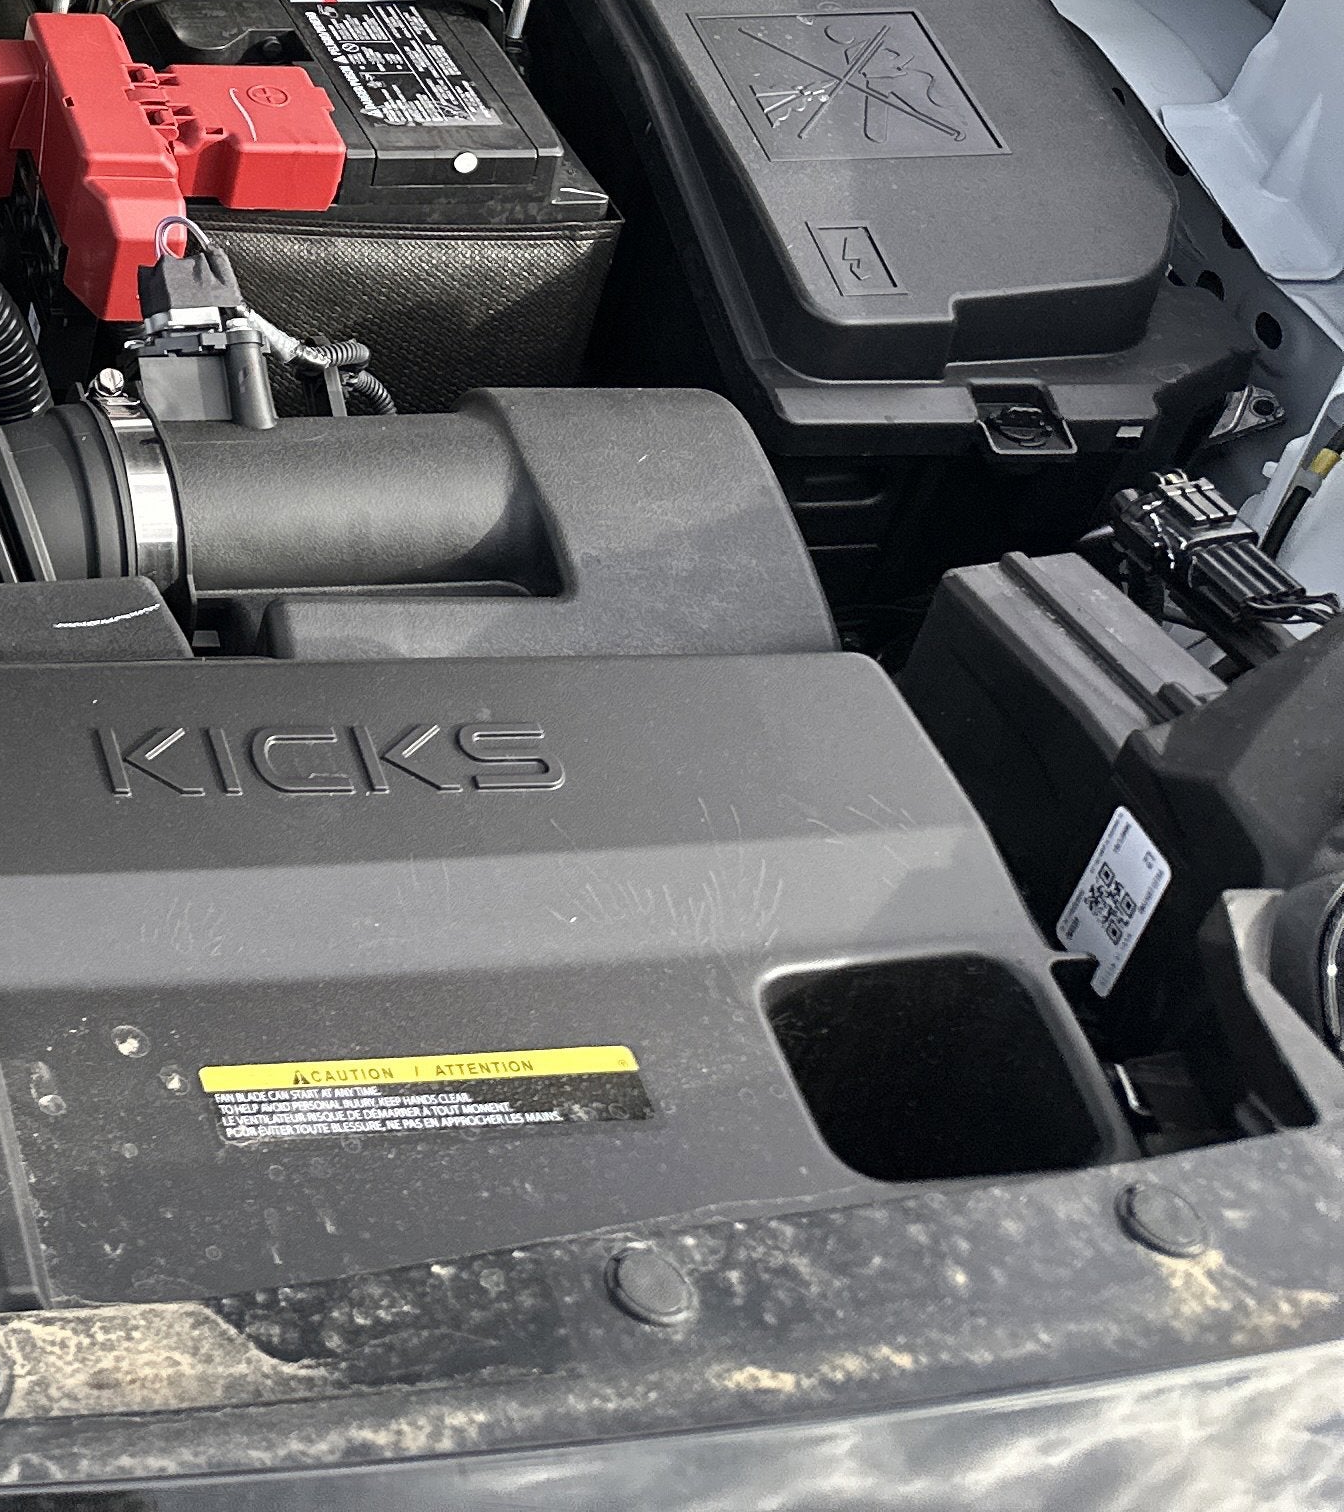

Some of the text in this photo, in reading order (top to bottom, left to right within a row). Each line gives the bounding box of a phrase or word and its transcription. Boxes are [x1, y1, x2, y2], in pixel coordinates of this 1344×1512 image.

[95, 721, 567, 798] KICKS
[311, 1067, 394, 1083] CAUTION
[435, 1059, 534, 1077] ATTENTION
[214, 1092, 234, 1104] FAN
[236, 1091, 267, 1103] BLADE
[269, 1090, 289, 1101] CAN
[291, 1089, 320, 1100] START
[321, 1088, 333, 1098] AT
[218, 1104, 233, 1115] TO
[235, 1103, 259, 1114] HELP
[261, 1102, 291, 1113] AVOID
[293, 1100, 341, 1112] PERSONAL
[377, 1096, 400, 1108] KEEP
[402, 1094, 437, 1105] HANDS
[438, 1092, 475, 1103] CLEAR.
[222, 1116, 237, 1127] LE
[238, 1112, 305, 1126] VENTILATEUR
[307, 1110, 347, 1122] RISQUE
[348, 1109, 362, 1120] DE
[363, 1105, 421, 1119] DÉMARRER
[432, 1105, 461, 1116] TOUT
[462, 1102, 515, 1114] MOMENT.
[226, 1126, 258, 1138] POUR
[294, 1122, 331, 1135] TOUTE
[332, 1121, 385, 1134] BLESSURE,
[387, 1120, 401, 1131] NE
[402, 1119, 422, 1129] PAS
[424, 1117, 440, 1128] EN
[441, 1114, 504, 1127] APPROCHER
[505, 1112, 524, 1124] LES
[525, 1110, 564, 1122] MAINS.
